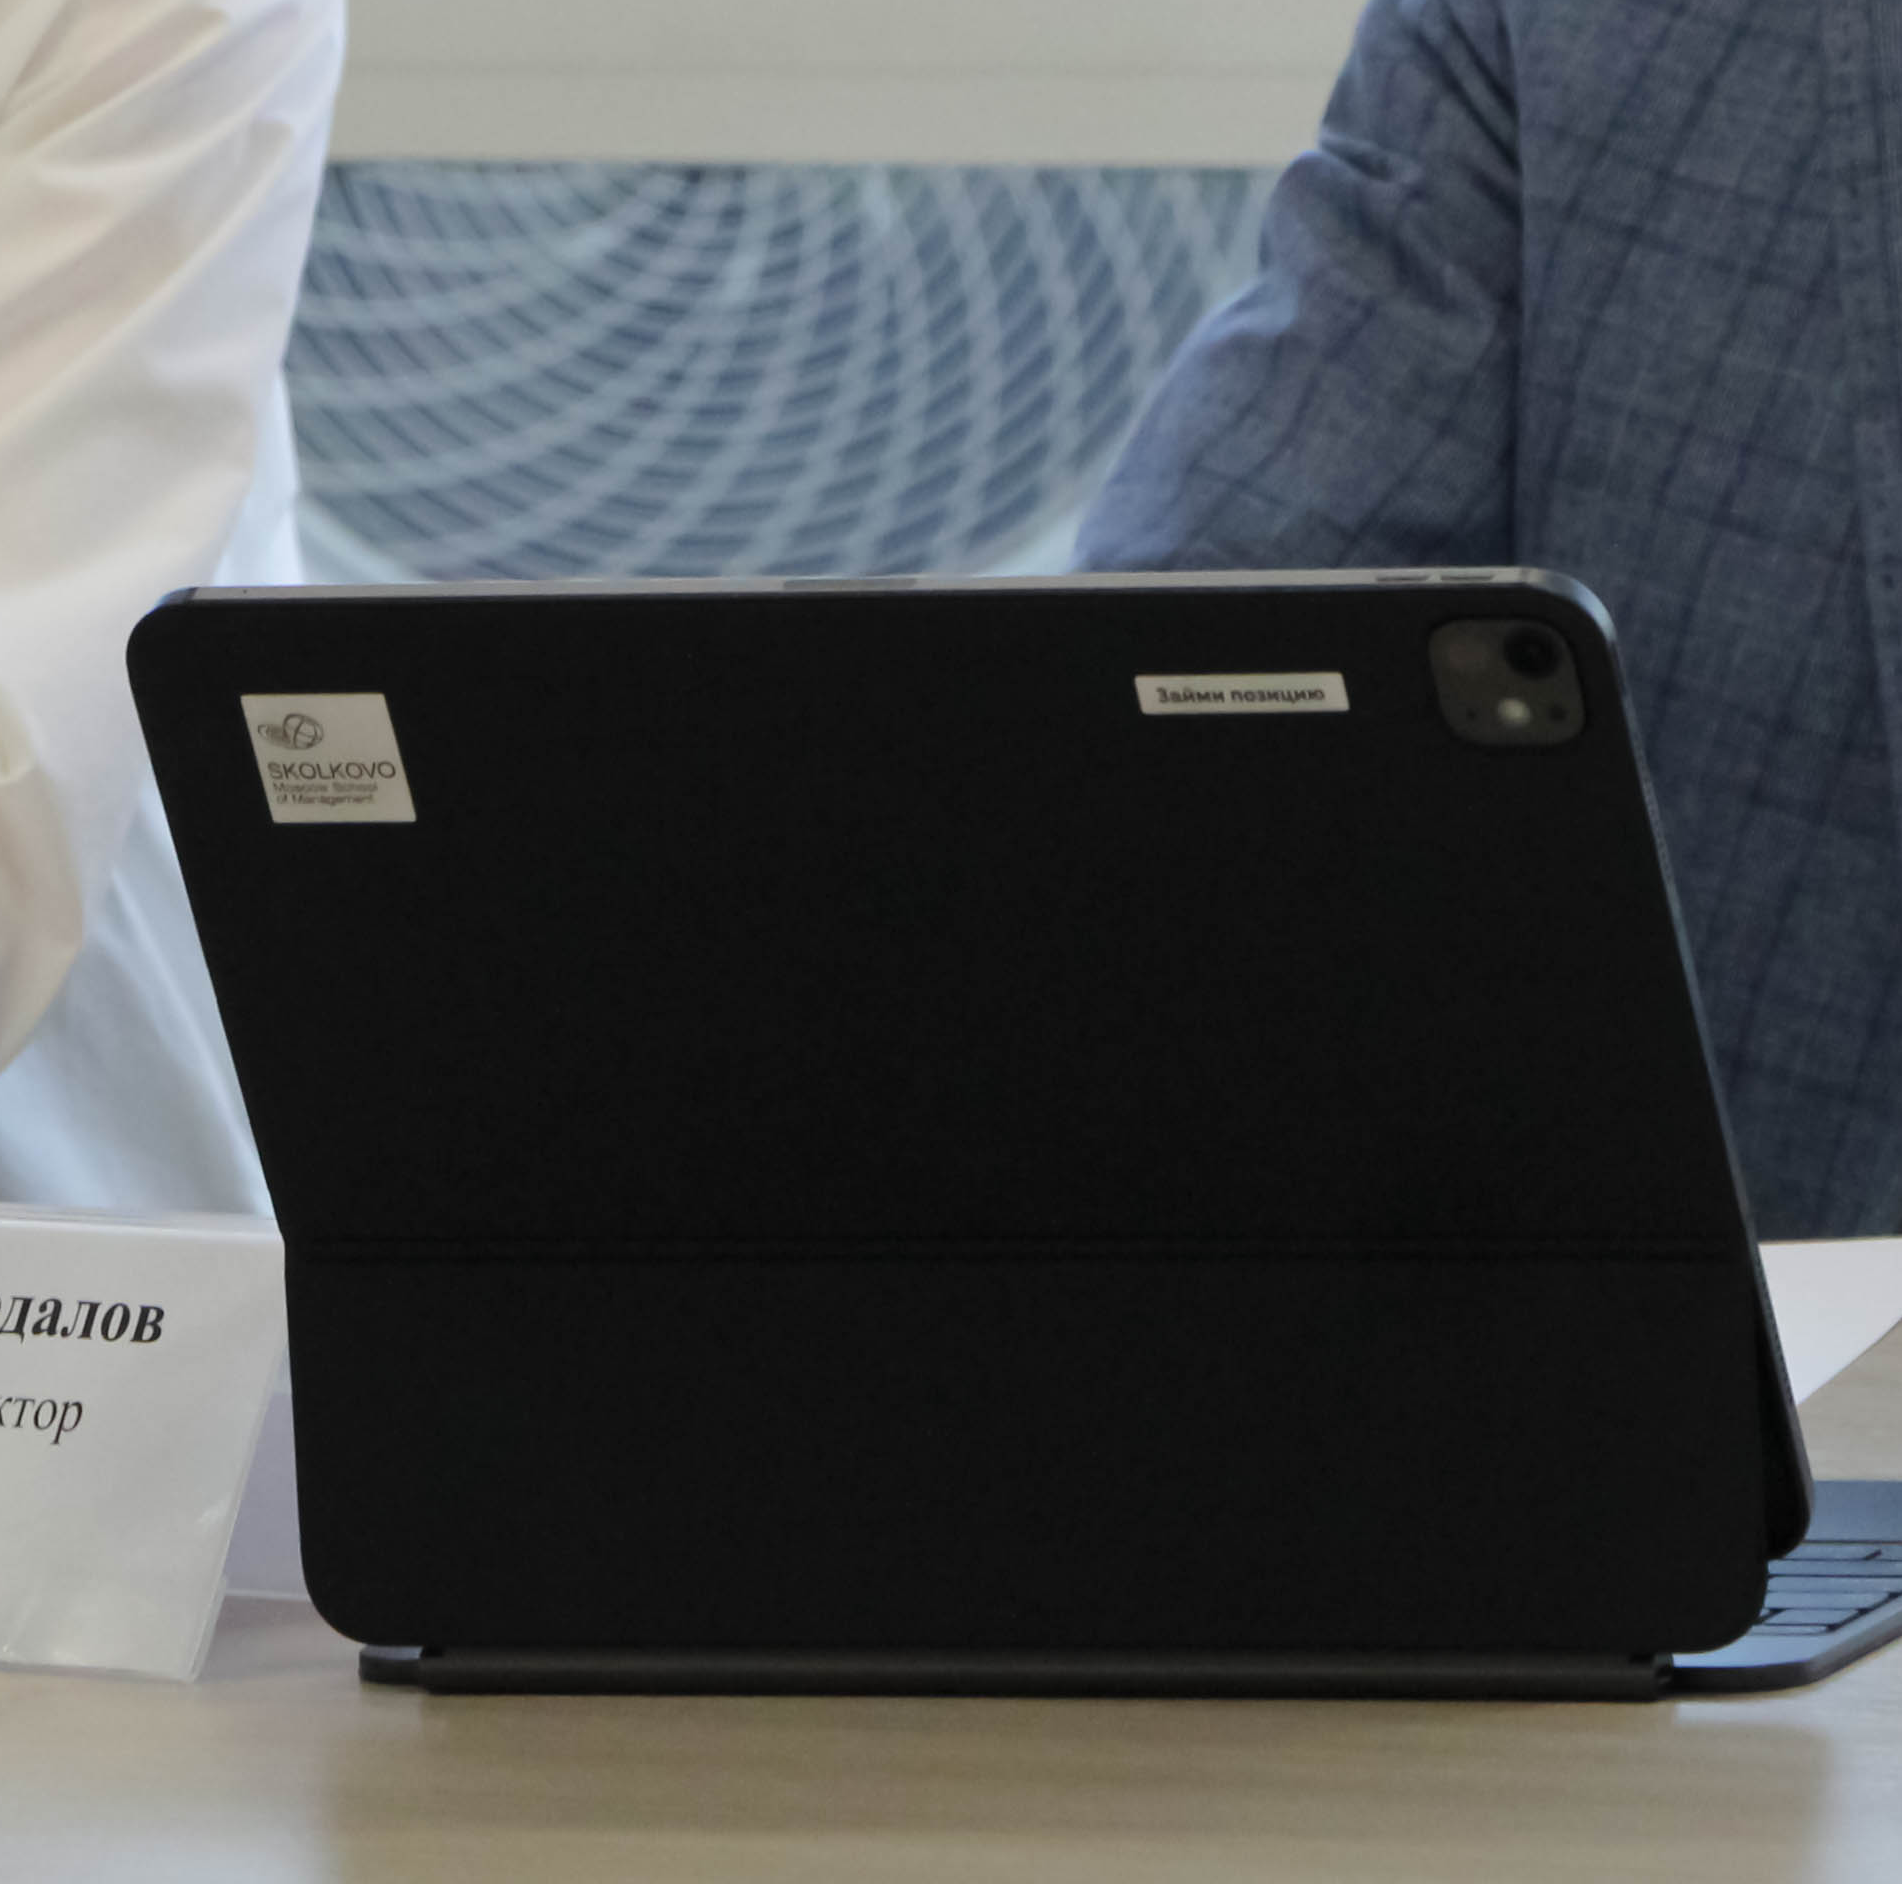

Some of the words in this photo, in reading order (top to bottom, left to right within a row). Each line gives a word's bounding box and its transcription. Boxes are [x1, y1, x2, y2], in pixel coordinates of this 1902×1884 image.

[1156, 687, 1225, 704] Займи
[1230, 689, 1325, 705] позицию
[267, 761, 397, 780] SKOLKOVO
